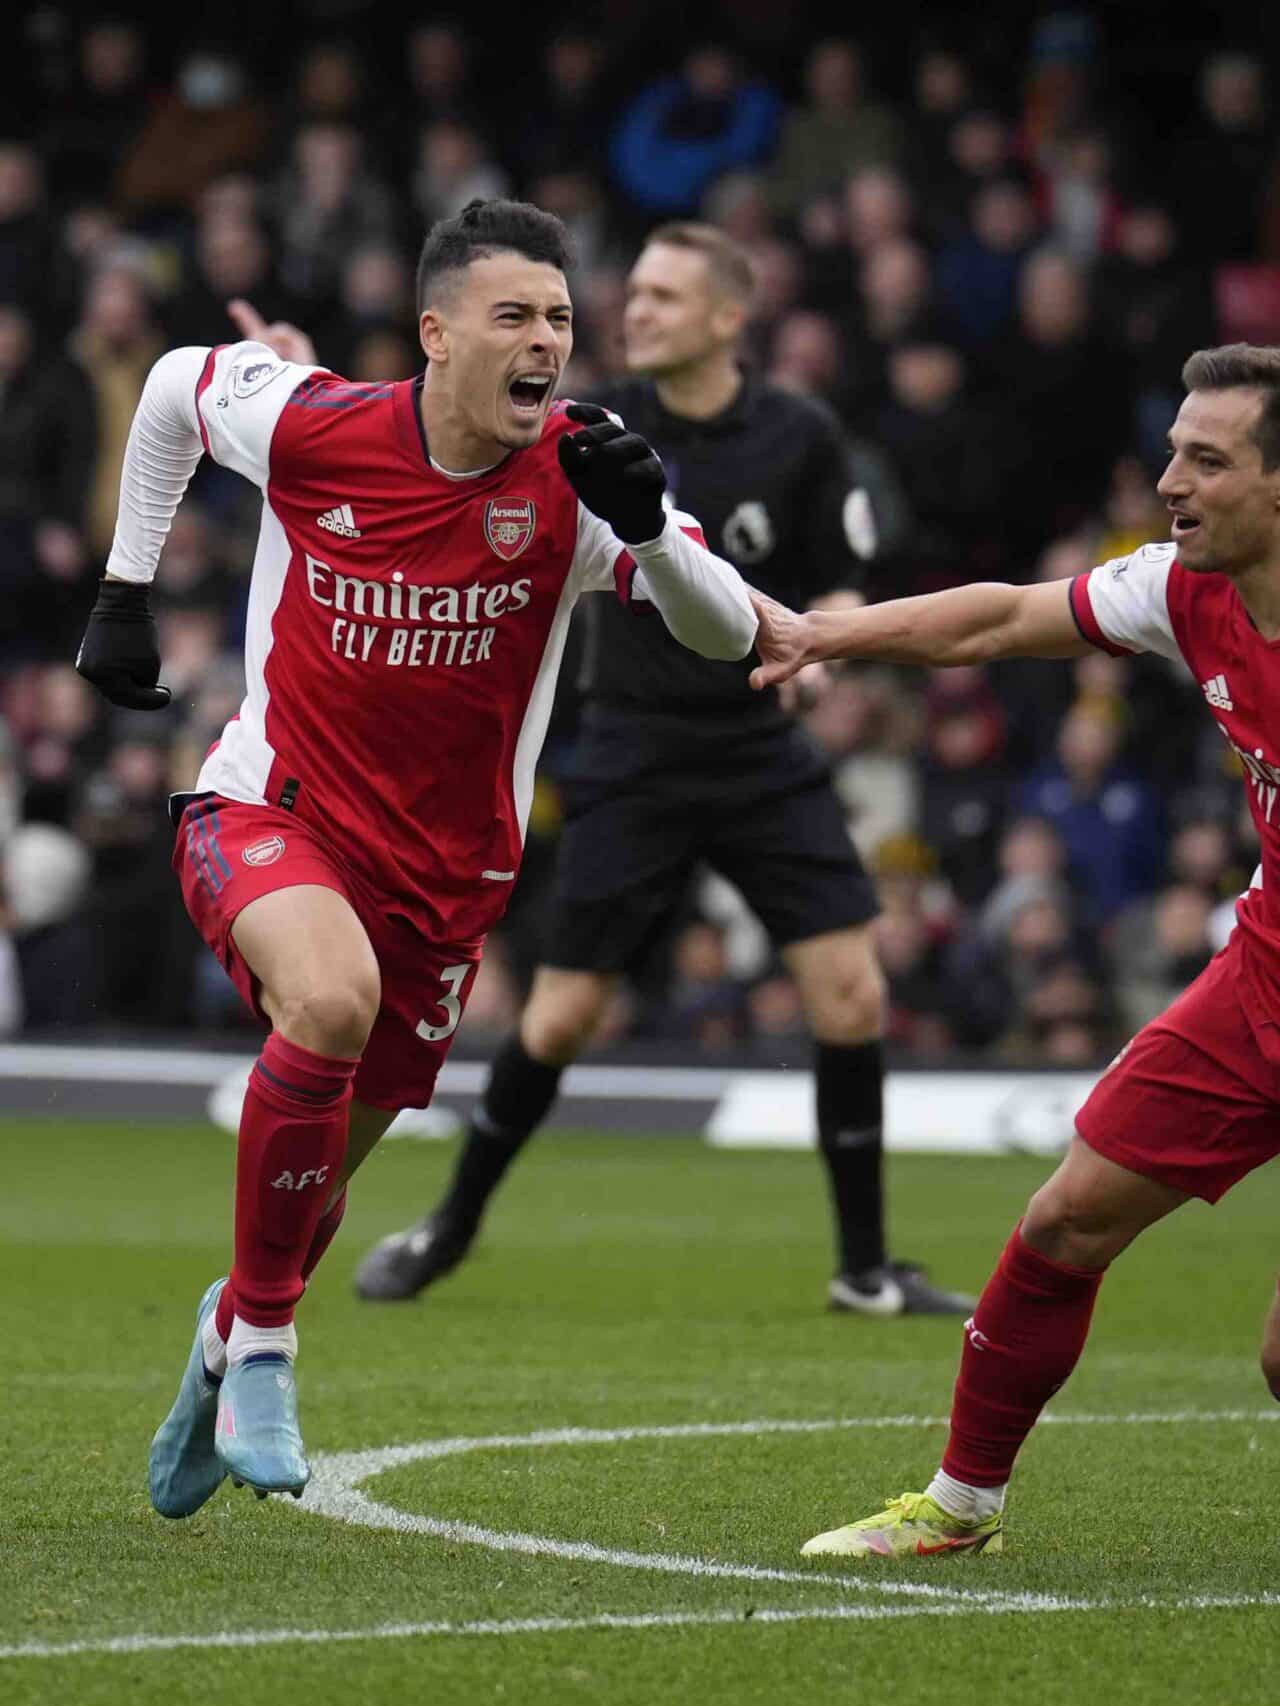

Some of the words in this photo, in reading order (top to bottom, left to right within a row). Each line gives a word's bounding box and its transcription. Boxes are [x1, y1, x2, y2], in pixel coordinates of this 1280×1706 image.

[491, 506, 529, 518] Arsenal
[316, 516, 362, 538] adidas
[305, 552, 532, 624] Emirates
[331, 617, 380, 663] FLY
[386, 626, 497, 667] BETTER
[270, 1165, 329, 1190] AFC
